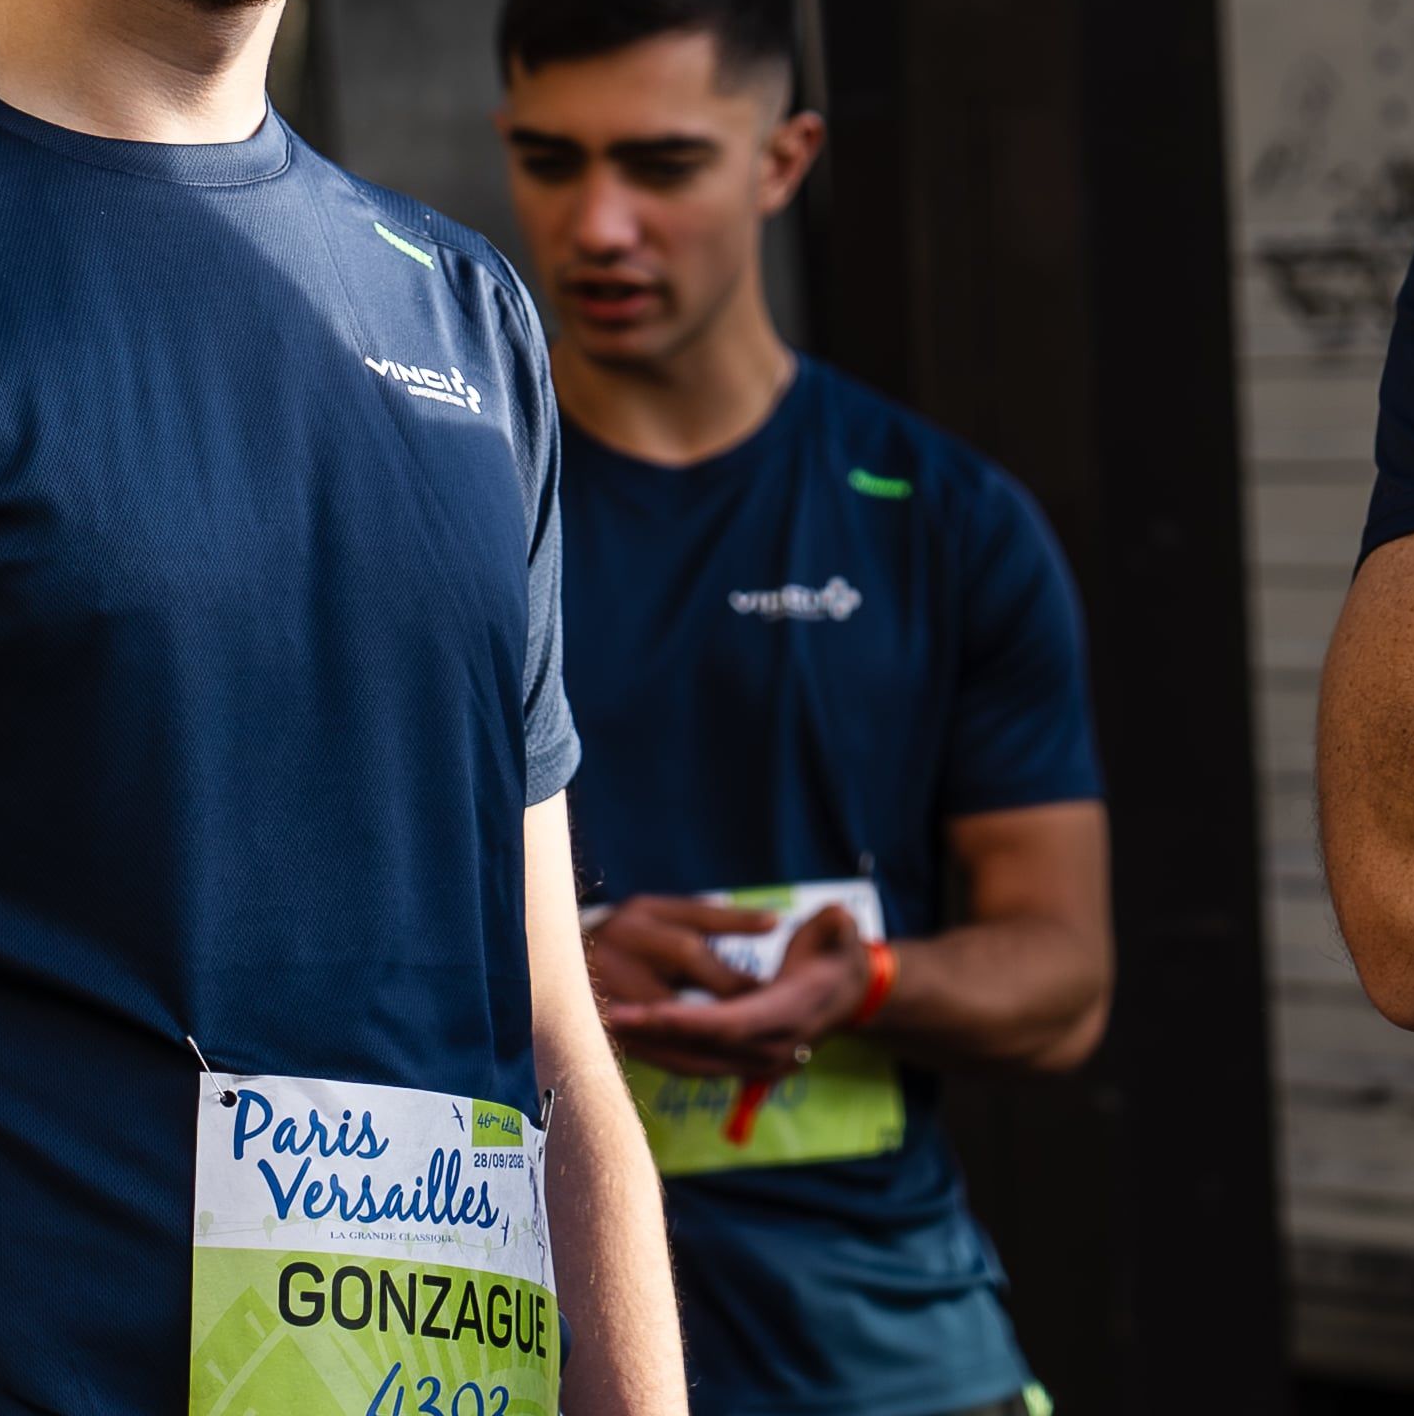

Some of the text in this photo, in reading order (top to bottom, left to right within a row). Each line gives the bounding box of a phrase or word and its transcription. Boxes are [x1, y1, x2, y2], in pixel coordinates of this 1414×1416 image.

[364, 356, 453, 393] VINCI
[233, 1089, 390, 1161] Paris
[257, 1147, 500, 1229] Versailles
[330, 1231, 455, 1244] LA GRANDE CLASSIQUE
[278, 1261, 548, 1359] GONZAGUE
